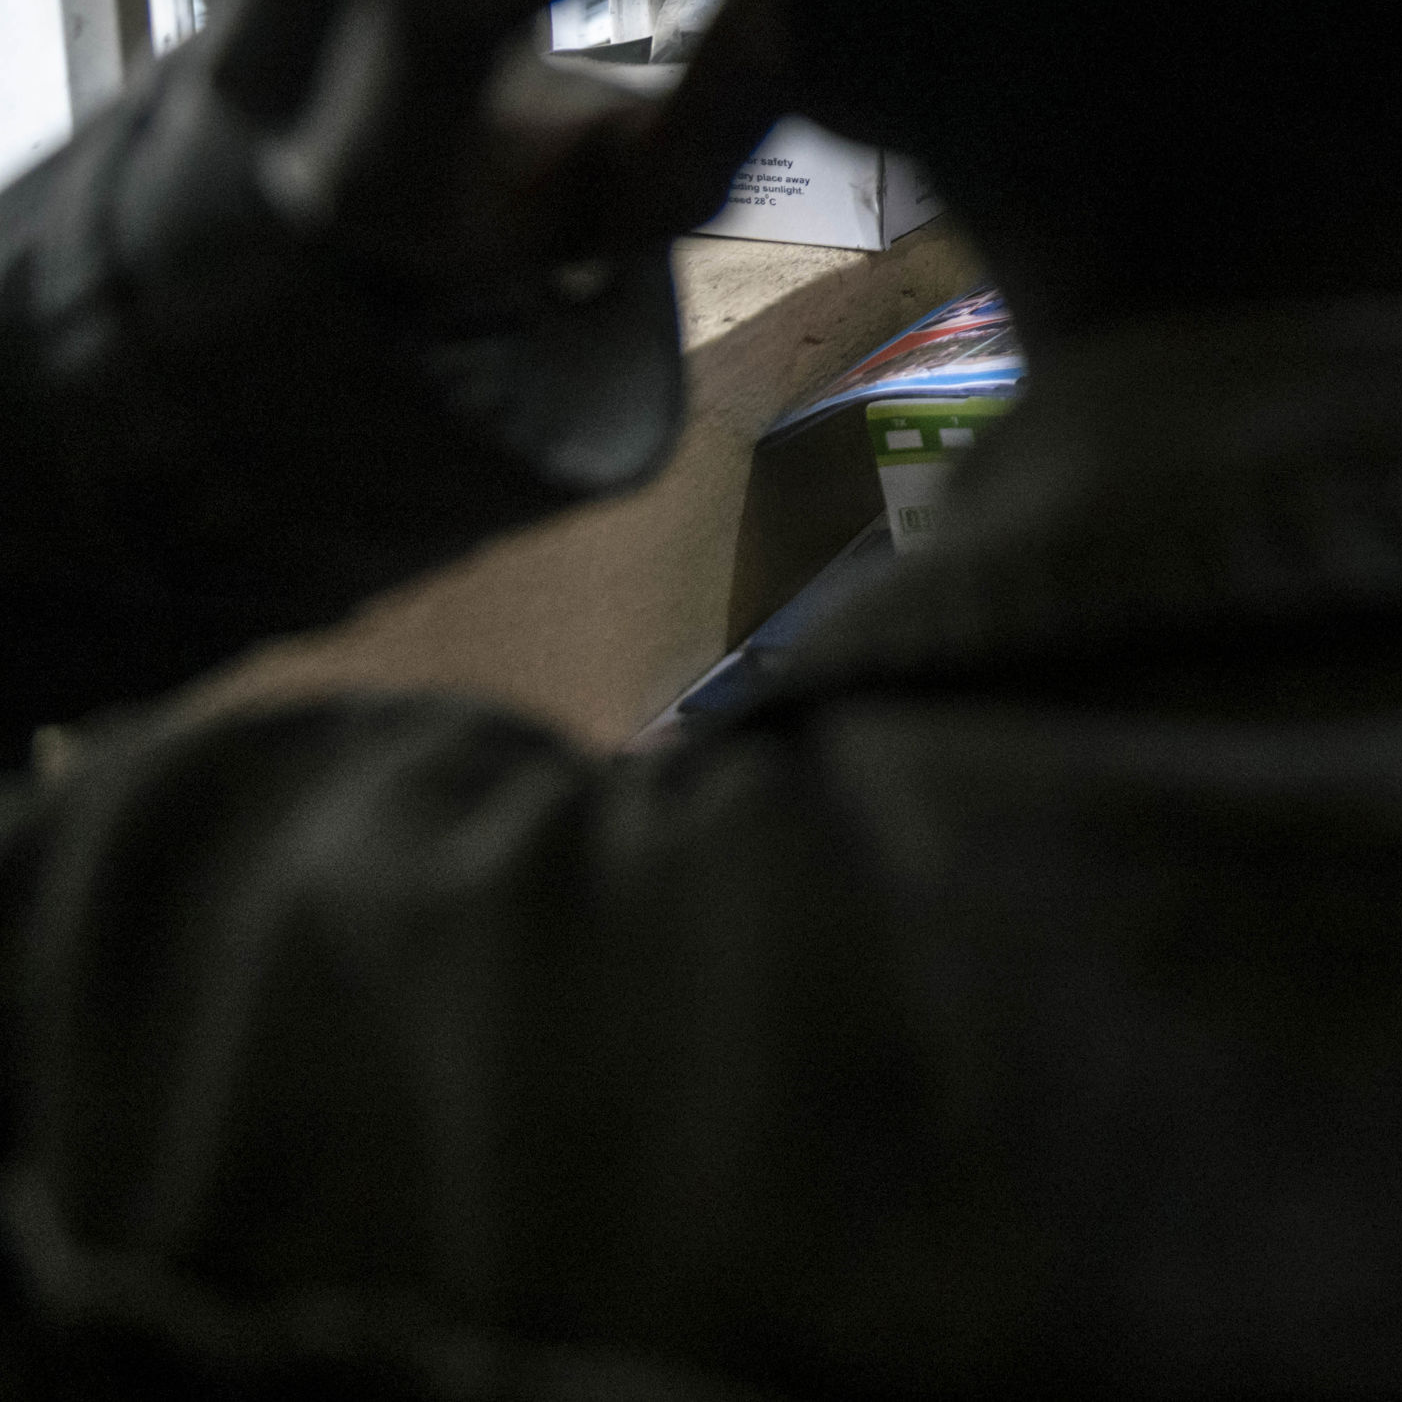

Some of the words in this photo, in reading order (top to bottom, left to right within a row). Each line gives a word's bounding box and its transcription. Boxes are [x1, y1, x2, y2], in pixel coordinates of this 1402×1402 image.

[760, 157, 794, 169] safety
[757, 173, 783, 183] place
[785, 177, 811, 186] away
[762, 184, 805, 196] sunlight.
